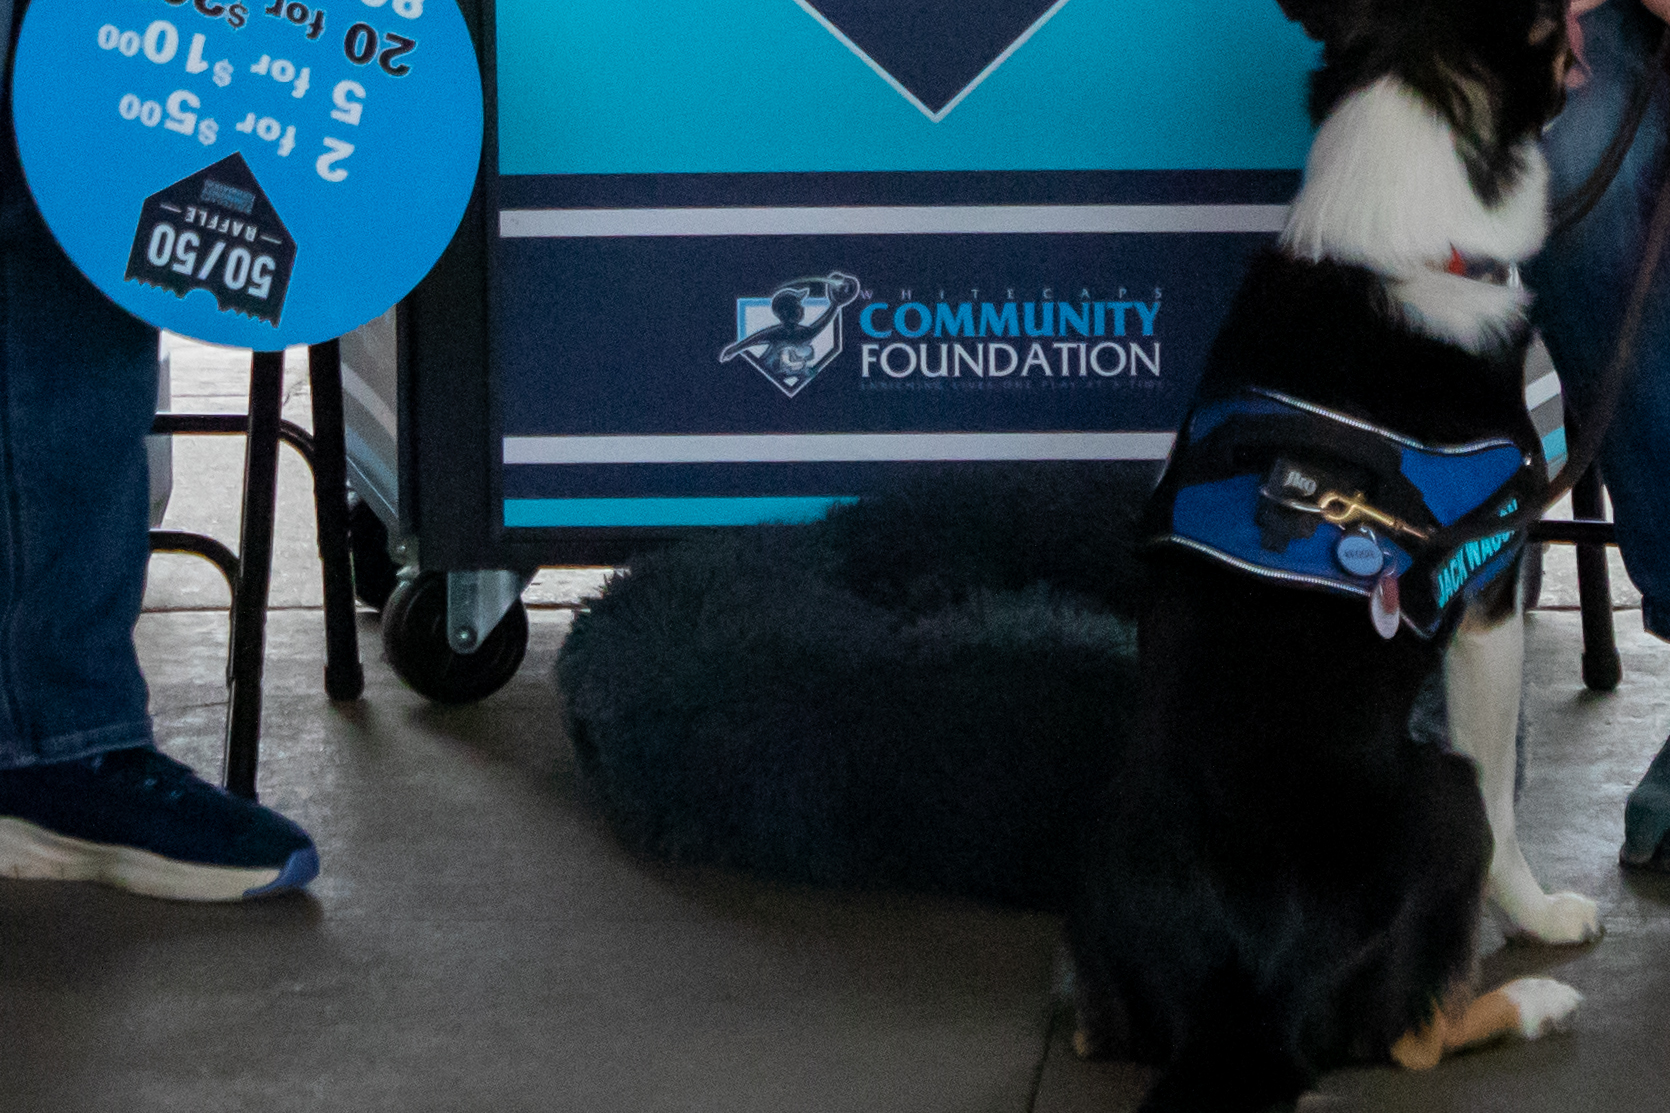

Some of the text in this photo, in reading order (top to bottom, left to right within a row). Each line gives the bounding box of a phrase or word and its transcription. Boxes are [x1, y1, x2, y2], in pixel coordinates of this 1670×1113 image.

[343, 22, 416, 77] 20
[250, 54, 311, 99] for
[330, 79, 367, 126] 5
[236, 112, 297, 158] for
[315, 136, 356, 183] 2
[184, 205, 258, 243] RAFFLE
[147, 222, 277, 300] 50/50
[860, 287, 1163, 300] WHITECAPS
[859, 301, 1161, 338] COMMUNITY
[861, 341, 1162, 378] FOUNDATION
